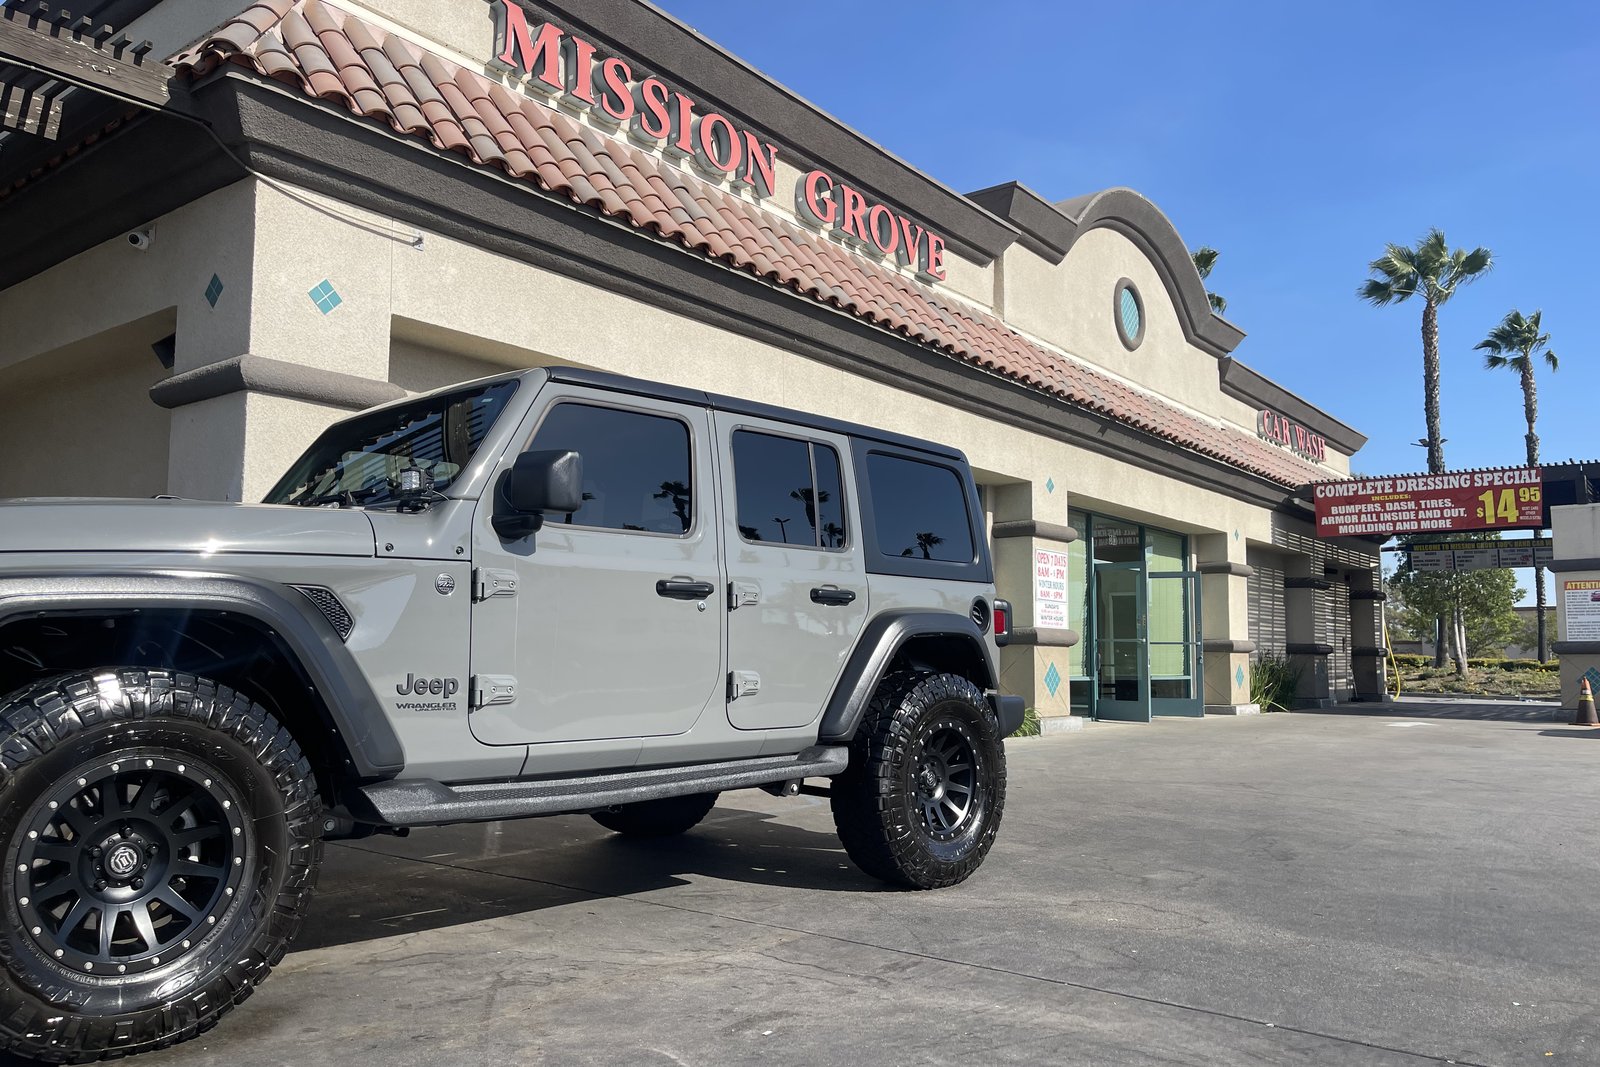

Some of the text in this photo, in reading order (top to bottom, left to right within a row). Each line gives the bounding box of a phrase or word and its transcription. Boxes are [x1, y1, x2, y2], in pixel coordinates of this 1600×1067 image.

[498, 0, 946, 282] MISSION GROVE
[1263, 409, 1327, 461] CAR WASH
[1316, 469, 1540, 498] COMPLETE DRESSING SPECIAL
[1321, 514, 1359, 525] ARMOR
[1360, 513, 1378, 523] ALL
[1380, 510, 1416, 521] INSIDE
[1418, 509, 1441, 519] AND
[1331, 503, 1384, 515] BUMPERS,
[1338, 519, 1452, 534] MOULDING AND MORE
[1036, 552, 1050, 564] OPEN
[1054, 555, 1067, 568] DAYS
[1038, 580, 1065, 591] WINTER HOURS
[1567, 581, 1600, 590] ATTENTI
[396, 672, 459, 699] Jeep
[396, 702, 457, 710] WRANGLER
